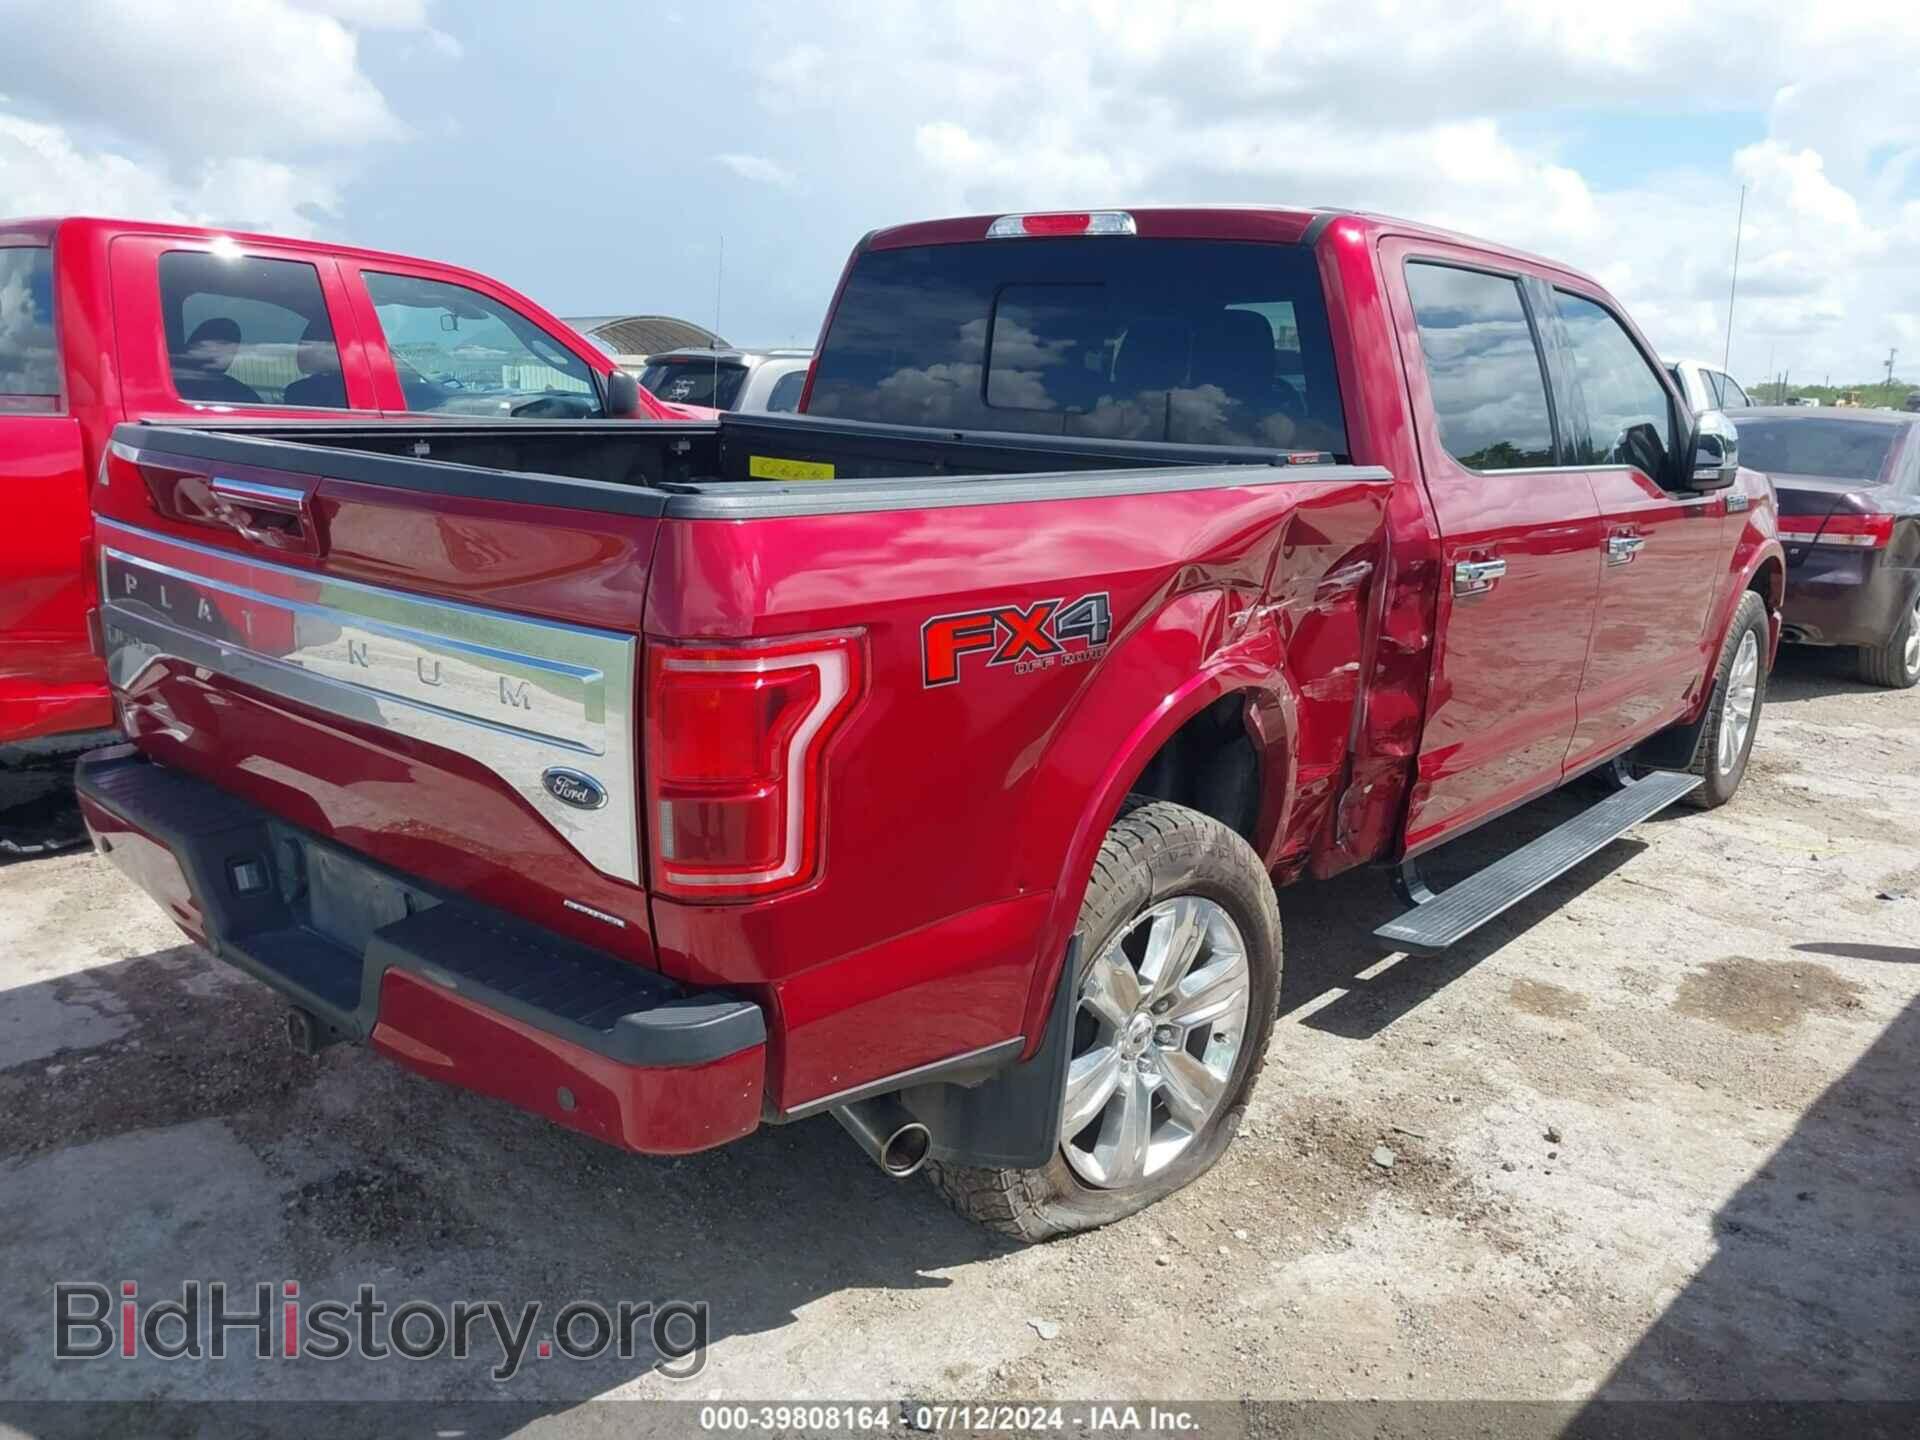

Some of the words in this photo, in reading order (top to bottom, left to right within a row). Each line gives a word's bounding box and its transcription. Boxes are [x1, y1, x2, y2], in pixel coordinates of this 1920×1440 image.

[921, 592, 1112, 689] FX4
[1014, 656, 1055, 675] OFF
[552, 774, 590, 804] Ford
